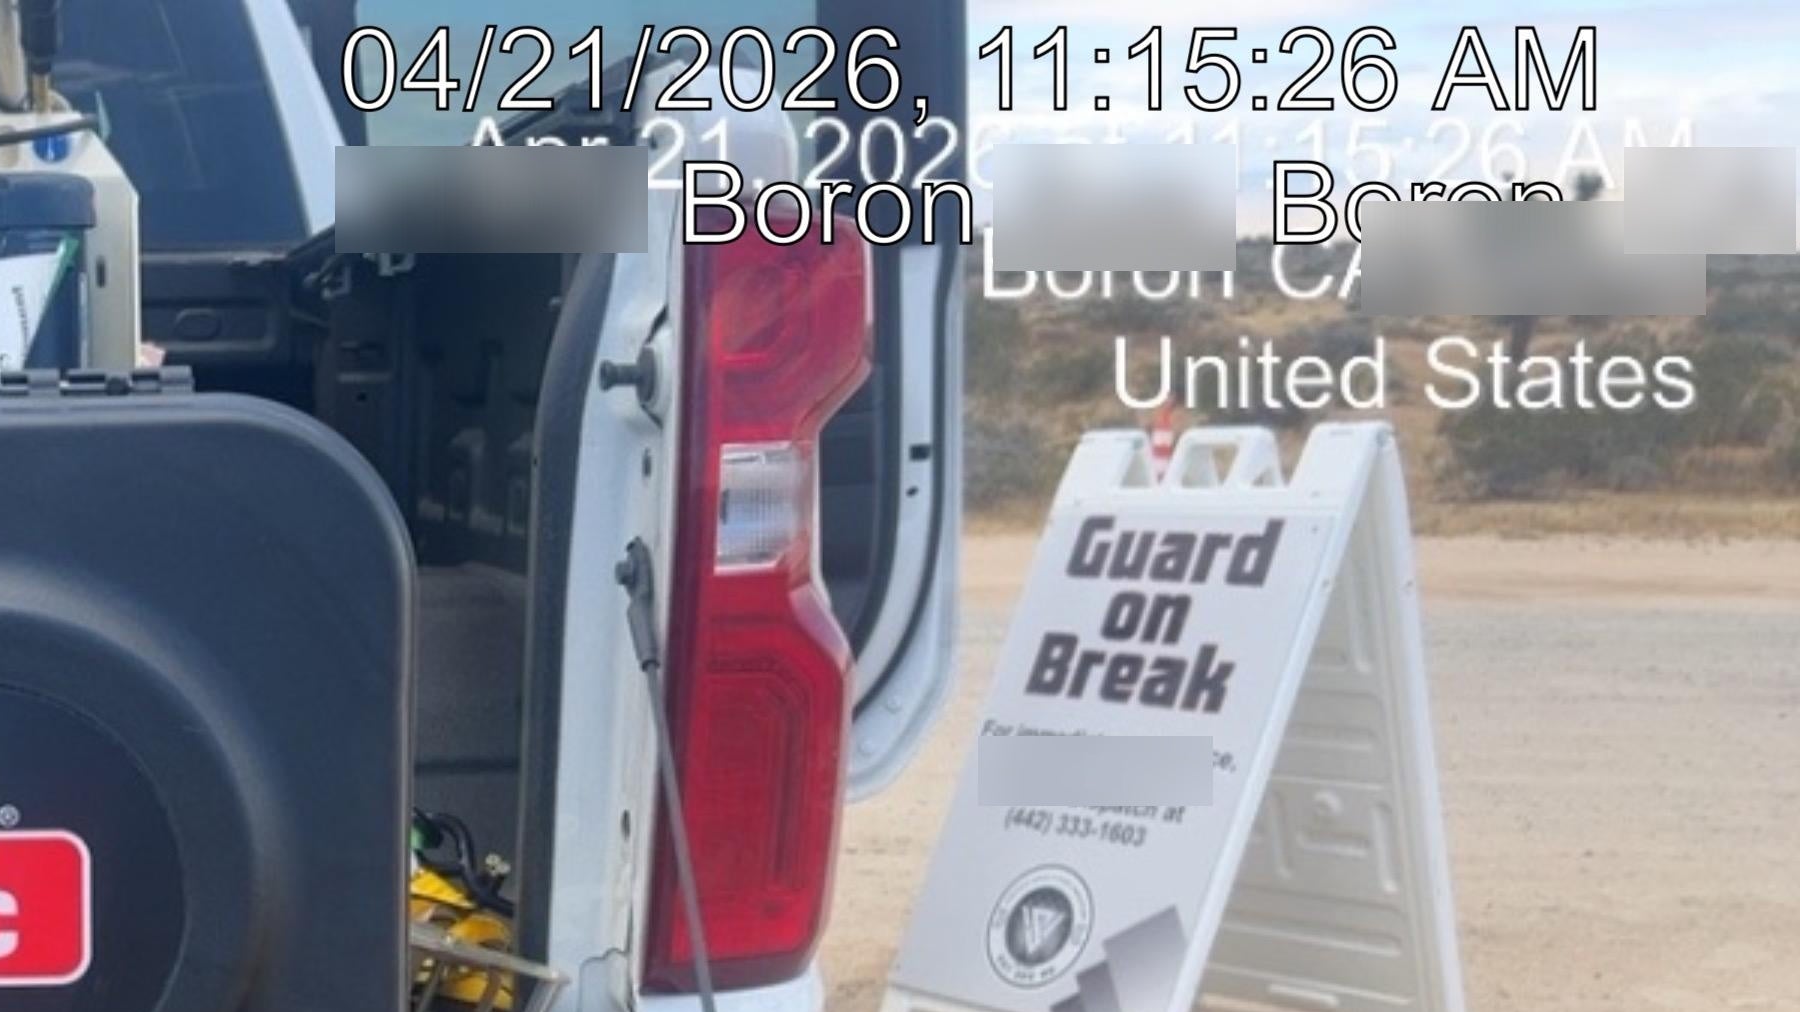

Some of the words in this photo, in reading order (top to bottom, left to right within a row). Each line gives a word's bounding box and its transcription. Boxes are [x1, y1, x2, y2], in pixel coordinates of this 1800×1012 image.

[1067, 515, 1284, 587] Guard
[1100, 590, 1193, 644] on
[1024, 632, 1236, 714] Break
